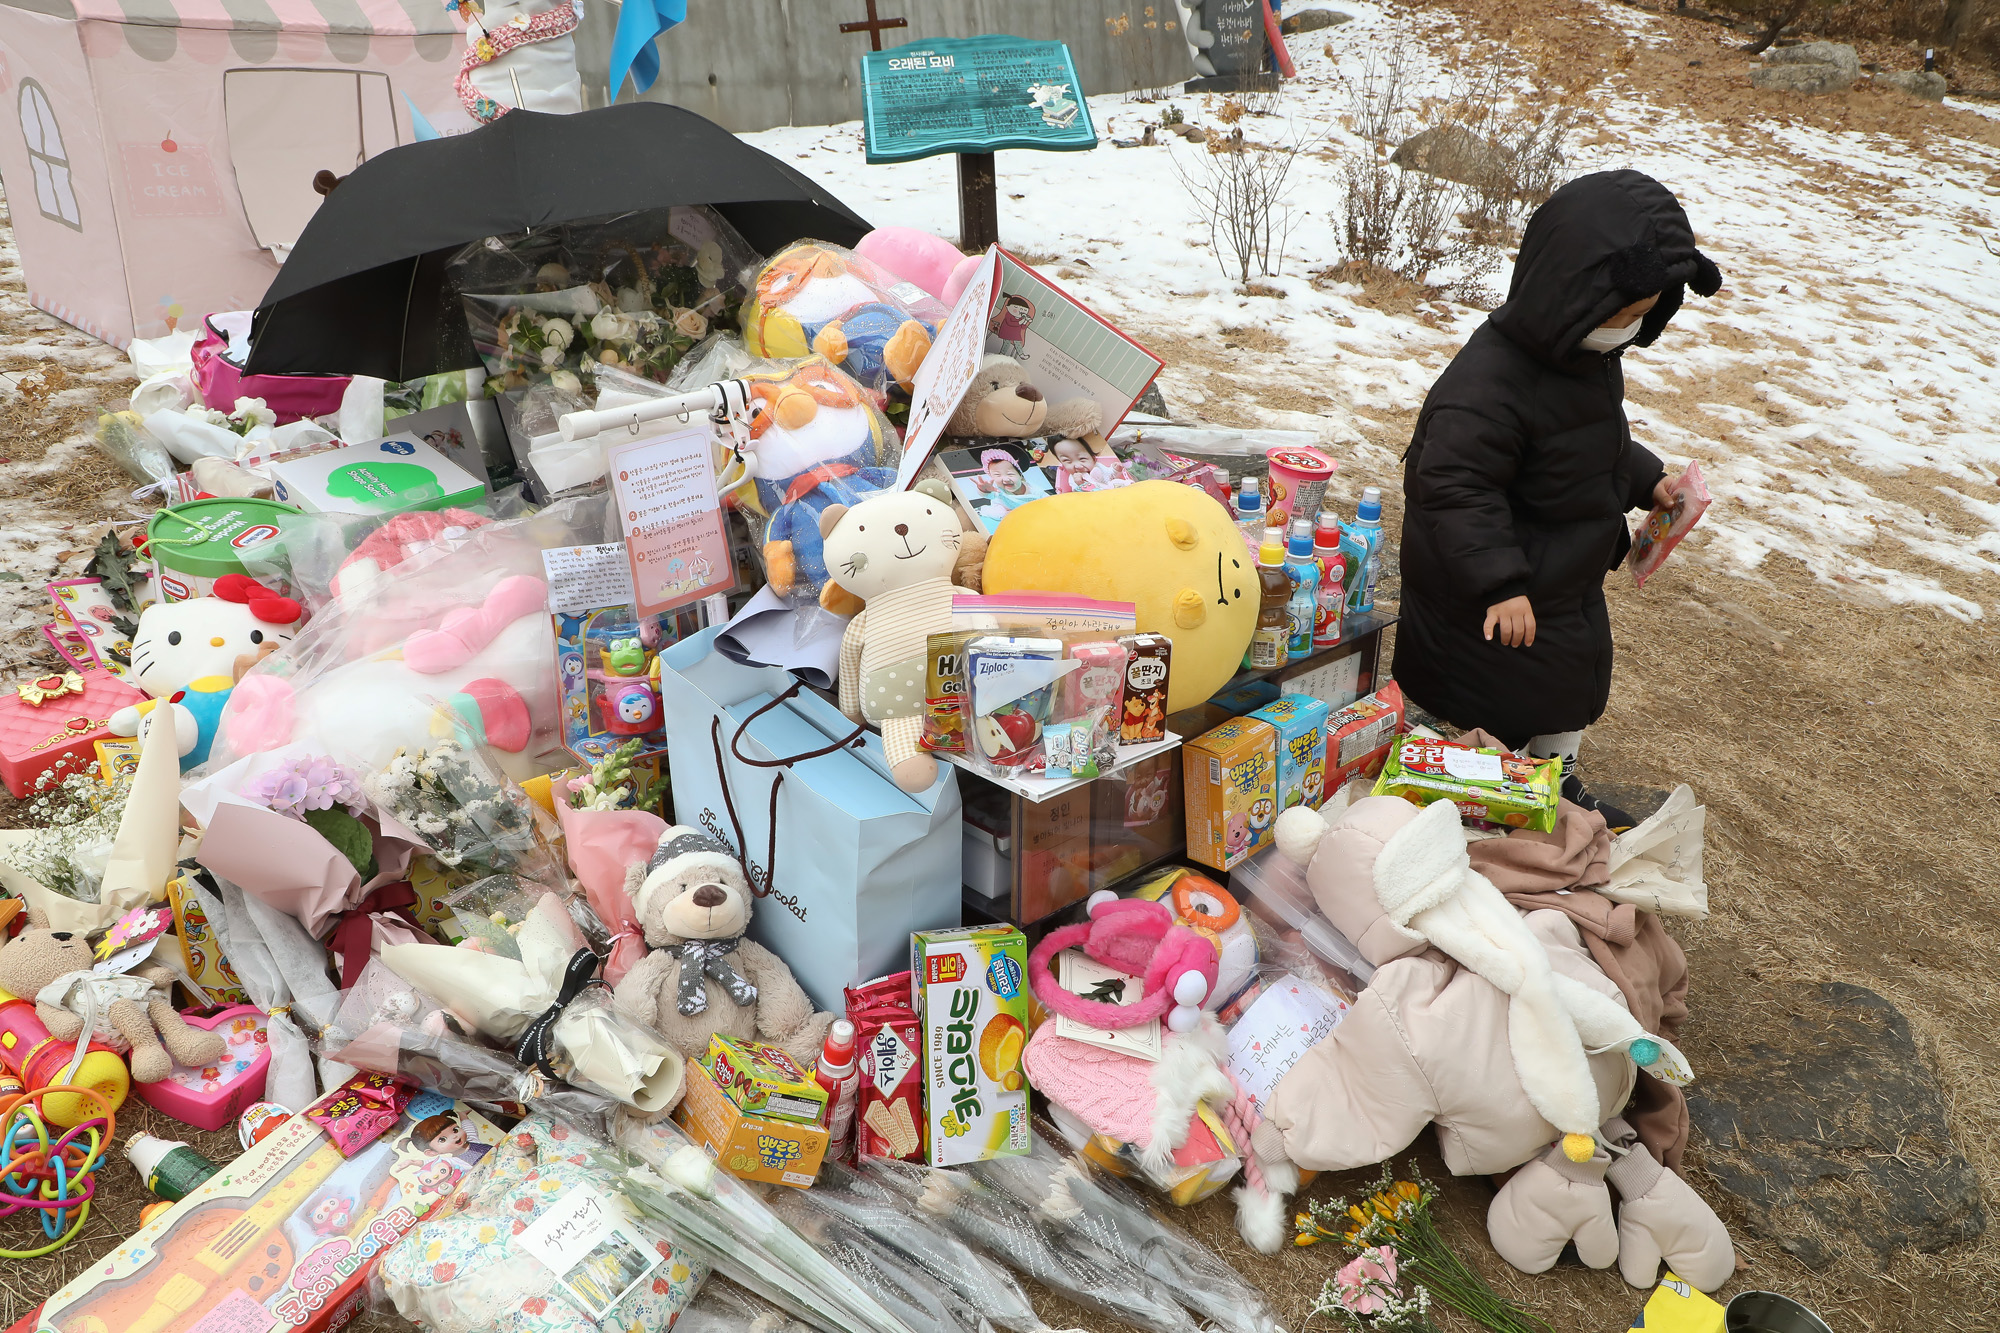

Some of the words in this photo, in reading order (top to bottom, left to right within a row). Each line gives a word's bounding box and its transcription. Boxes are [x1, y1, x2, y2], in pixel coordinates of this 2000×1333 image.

[888, 57, 927, 70] 오래된
[930, 55, 955, 68] 묘비
[152, 163, 190, 177] ICE
[144, 185, 206, 198] CREAM
[630, 467, 643, 476] 선물은
[644, 464, 658, 472] 아크릴
[680, 453, 702, 464] 놓아주세요
[346, 470, 366, 486] Shape
[364, 482, 384, 498] Sorter
[357, 468, 380, 484] Activity
[646, 484, 658, 492] 선물은
[638, 509, 648, 518] 꽃은
[686, 494, 704, 502] 충분해요
[205, 510, 243, 531] Building
[642, 520, 660, 532] 음식물은
[690, 508, 703, 516] 주세요
[208, 520, 248, 542] Wooden
[643, 532, 652, 540] 주변
[654, 526, 676, 537] 야생동물의
[646, 547, 660, 556] 정인이
[648, 556, 663, 564] 정인이
[1046, 618, 1078, 630] 정인아
[1082, 620, 1114, 632] 사랑해
[980, 662, 1008, 676] Ziploc
[1130, 664, 1162, 680] 꿀딴지
[1083, 675, 1117, 688] 꿀딴지
[1229, 752, 1268, 787] 뽀로로와
[1240, 776, 1259, 794] 친구들
[1050, 802, 1070, 822] 정인
[750, 860, 808, 923] Chocolat
[940, 956, 957, 981] 1등
[992, 958, 1012, 995] 오리지널
[934, 1026, 944, 1052] 1989
[866, 1049, 876, 1077] Original
[876, 1033, 896, 1088] 웨하스
[896, 1050, 910, 1070] 딸기
[946, 988, 981, 1123] 카스타드
[1240, 1068, 1254, 1082] 그
[1251, 1024, 1294, 1068] 곳에서는
[716, 1054, 732, 1082] 초코송이
[934, 1054, 946, 1088] SINCE
[356, 1110, 372, 1130] mini
[1010, 1108, 1020, 1124] 우유
[748, 1124, 764, 1132] 빙그레
[758, 1135, 802, 1160] 뽀로로와
[234, 1169, 257, 1186] 콩순이
[258, 1136, 290, 1170] 바이올린으로
[762, 1156, 787, 1170] 친구들
[250, 1174, 266, 1184] 멋진
[544, 1220, 576, 1252] 사랑해
[572, 1196, 602, 1218] 정인아
[278, 1276, 337, 1324] 콩순이
[334, 1206, 418, 1278] 바이올린
[302, 1248, 343, 1284] 노래하는
